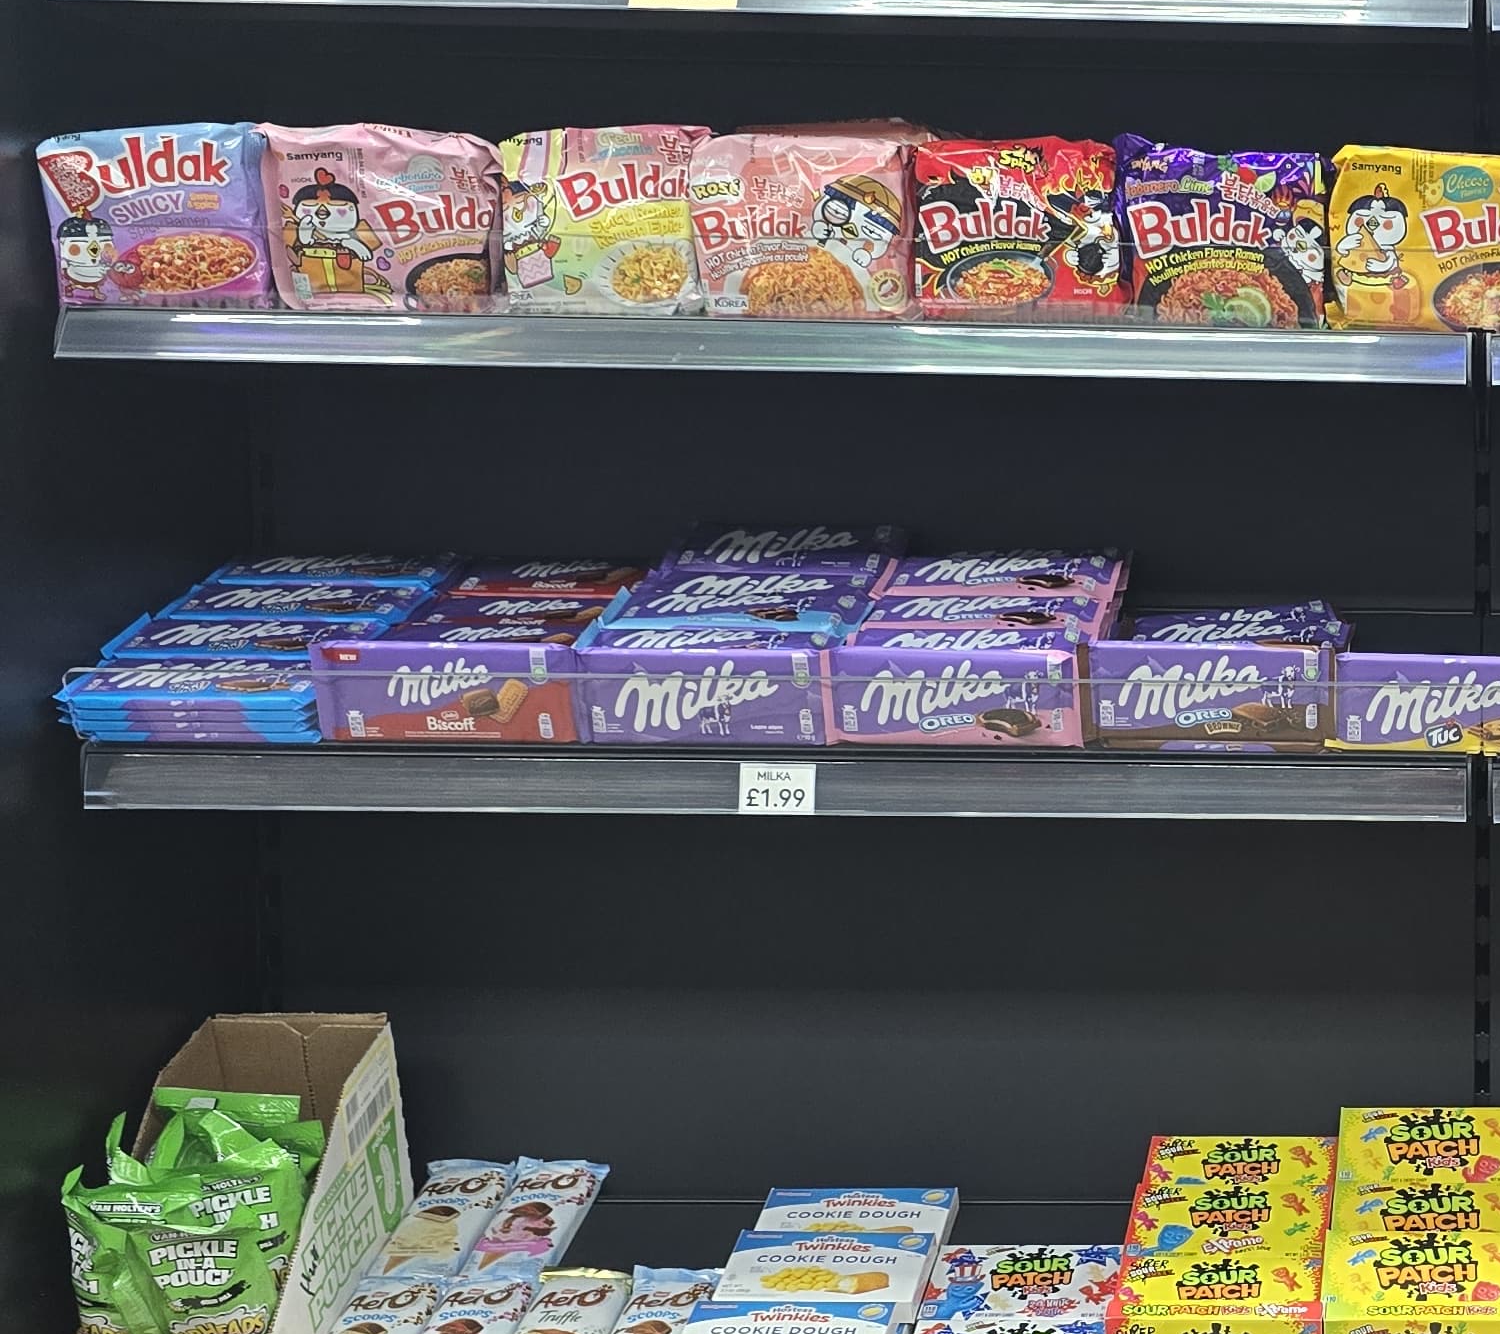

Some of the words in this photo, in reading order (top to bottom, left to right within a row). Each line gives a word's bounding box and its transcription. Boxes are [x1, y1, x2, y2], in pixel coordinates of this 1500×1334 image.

[286, 149, 342, 163] Samyang
[39, 136, 228, 211] Buldak
[1351, 162, 1401, 174] Samyang
[1446, 173, 1489, 192] Cheese
[112, 194, 182, 224] SWICY
[1130, 200, 1271, 255] Buldak
[1145, 255, 1168, 274] HOT
[1169, 250, 1203, 263] Chicken
[1205, 248, 1233, 259] Flavor
[1234, 251, 1264, 261] Ramen
[1149, 267, 1182, 286] Nouilles
[705, 527, 857, 564] Milka
[615, 661, 778, 730] Milka
[427, 716, 476, 732] Biscoff
[925, 714, 974, 730] OREO
[1428, 726, 1461, 744] TUC
[757, 772, 791, 781] MILKA
[746, 788, 805, 809] £1.99
[149, 1238, 238, 1264] PICKLE
[342, 1311, 397, 1324] SCOOPS
[541, 1310, 581, 1324] Truffle
[1121, 1304, 1168, 1316] SOUR
[1169, 1304, 1220, 1315] PATCH
